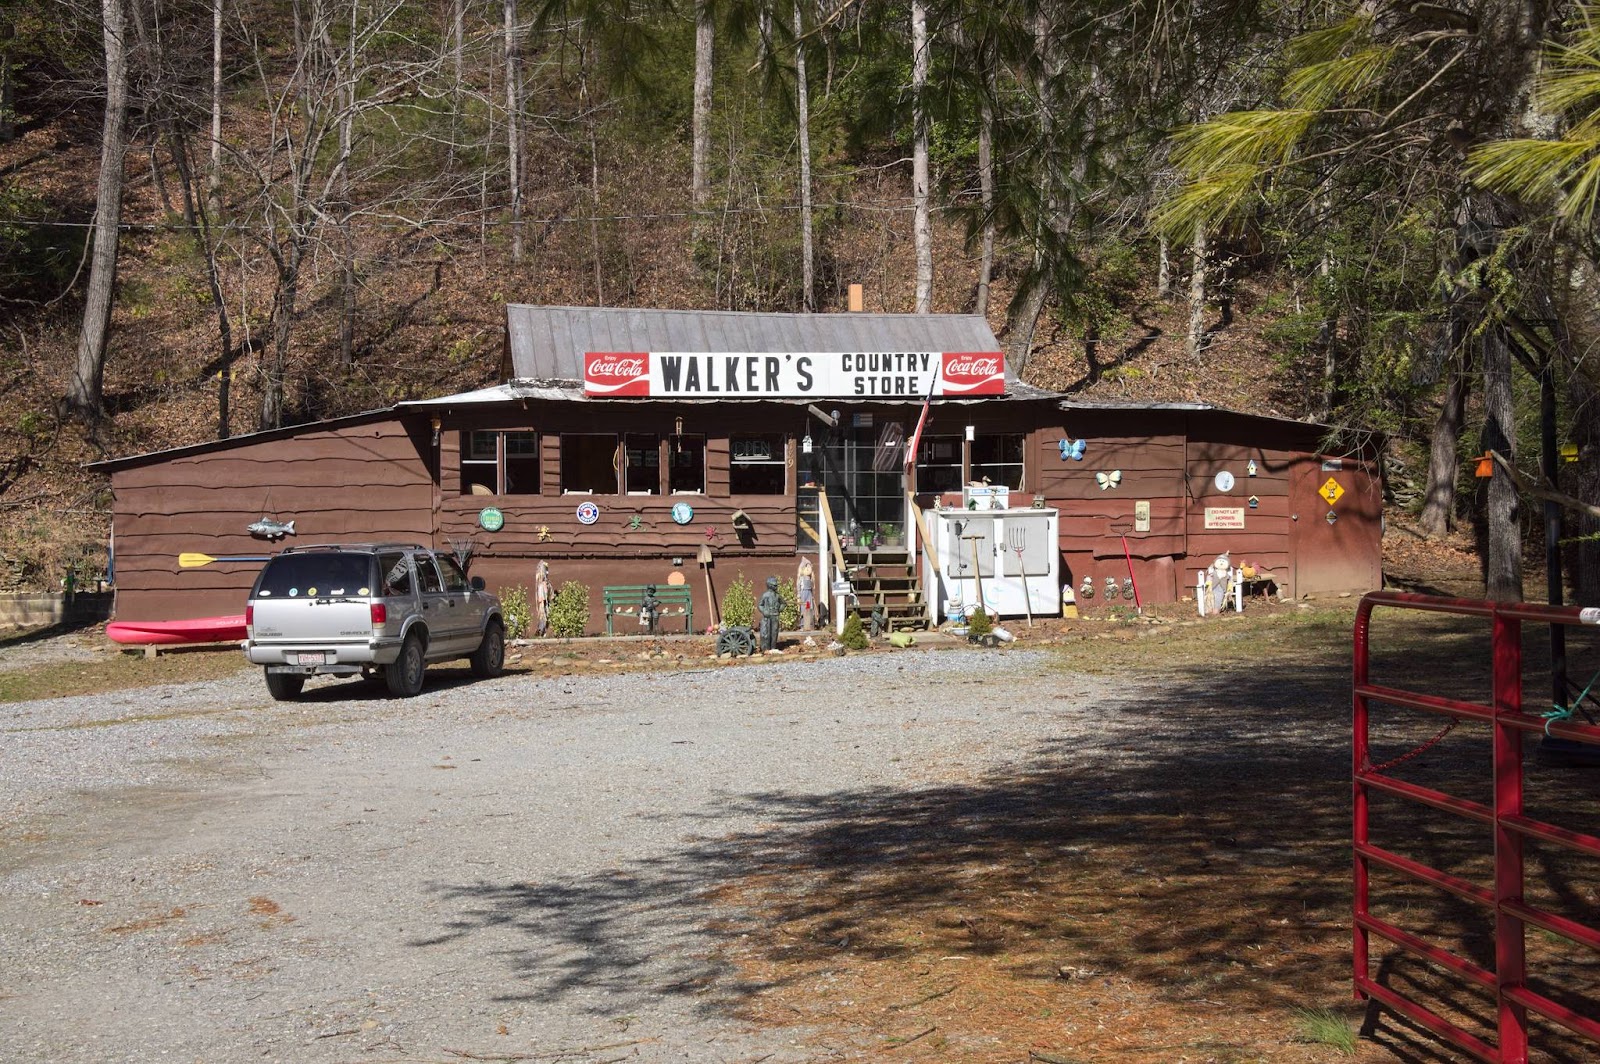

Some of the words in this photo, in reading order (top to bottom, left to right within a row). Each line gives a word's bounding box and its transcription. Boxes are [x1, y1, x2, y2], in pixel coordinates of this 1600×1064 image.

[588, 358, 644, 376] Coca-Cola
[842, 354, 930, 372] COUNTRY
[946, 358, 1000, 376] Coca-Cola
[660, 354, 813, 392] WALKER'S
[854, 376, 918, 394] STORE
